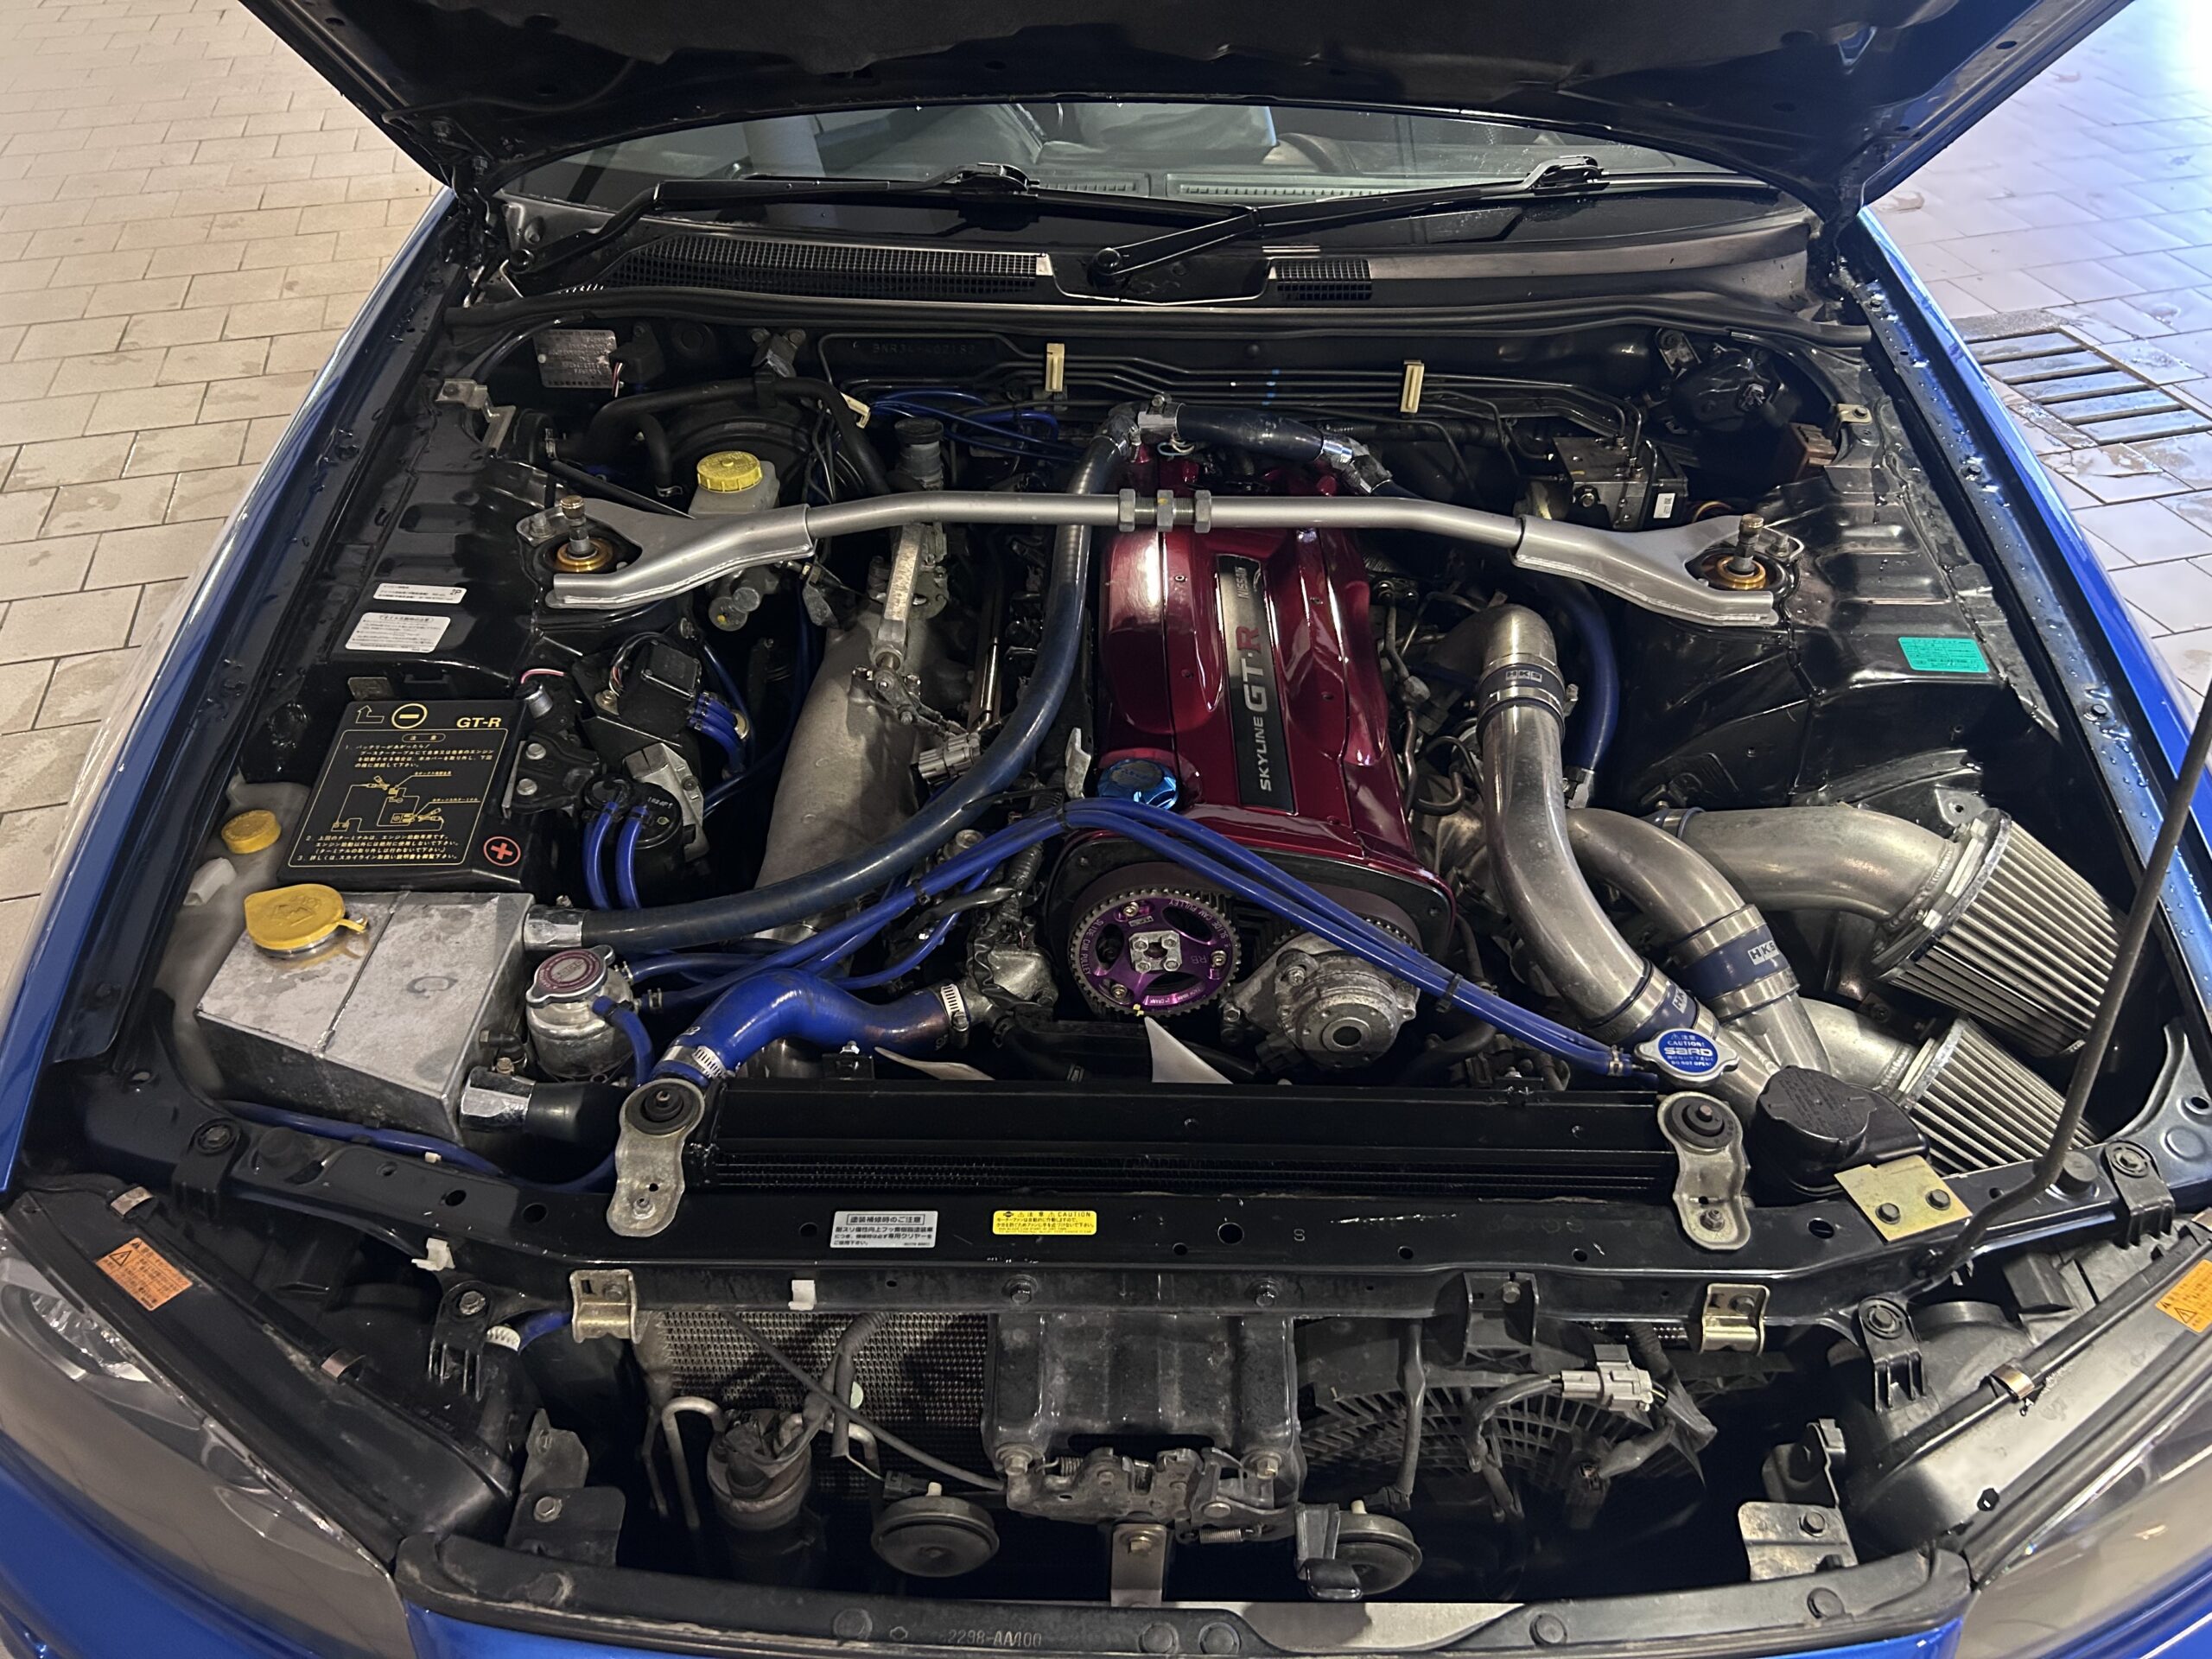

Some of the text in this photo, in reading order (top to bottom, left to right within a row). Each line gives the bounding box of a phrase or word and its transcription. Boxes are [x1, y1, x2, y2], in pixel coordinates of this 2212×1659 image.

[1236, 566, 1249, 600] NISSAN
[1506, 671, 1541, 682] HKS
[456, 716, 502, 728] GT-R
[1254, 716, 1272, 792] SKYLINE
[1086, 918, 1104, 938] SLIDE
[1168, 899, 1229, 939] SLIDE CAM PULLEY
[1190, 955, 1208, 964] RB
[1750, 942, 1776, 959] HKS
[1079, 953, 1092, 975] PULLEY
